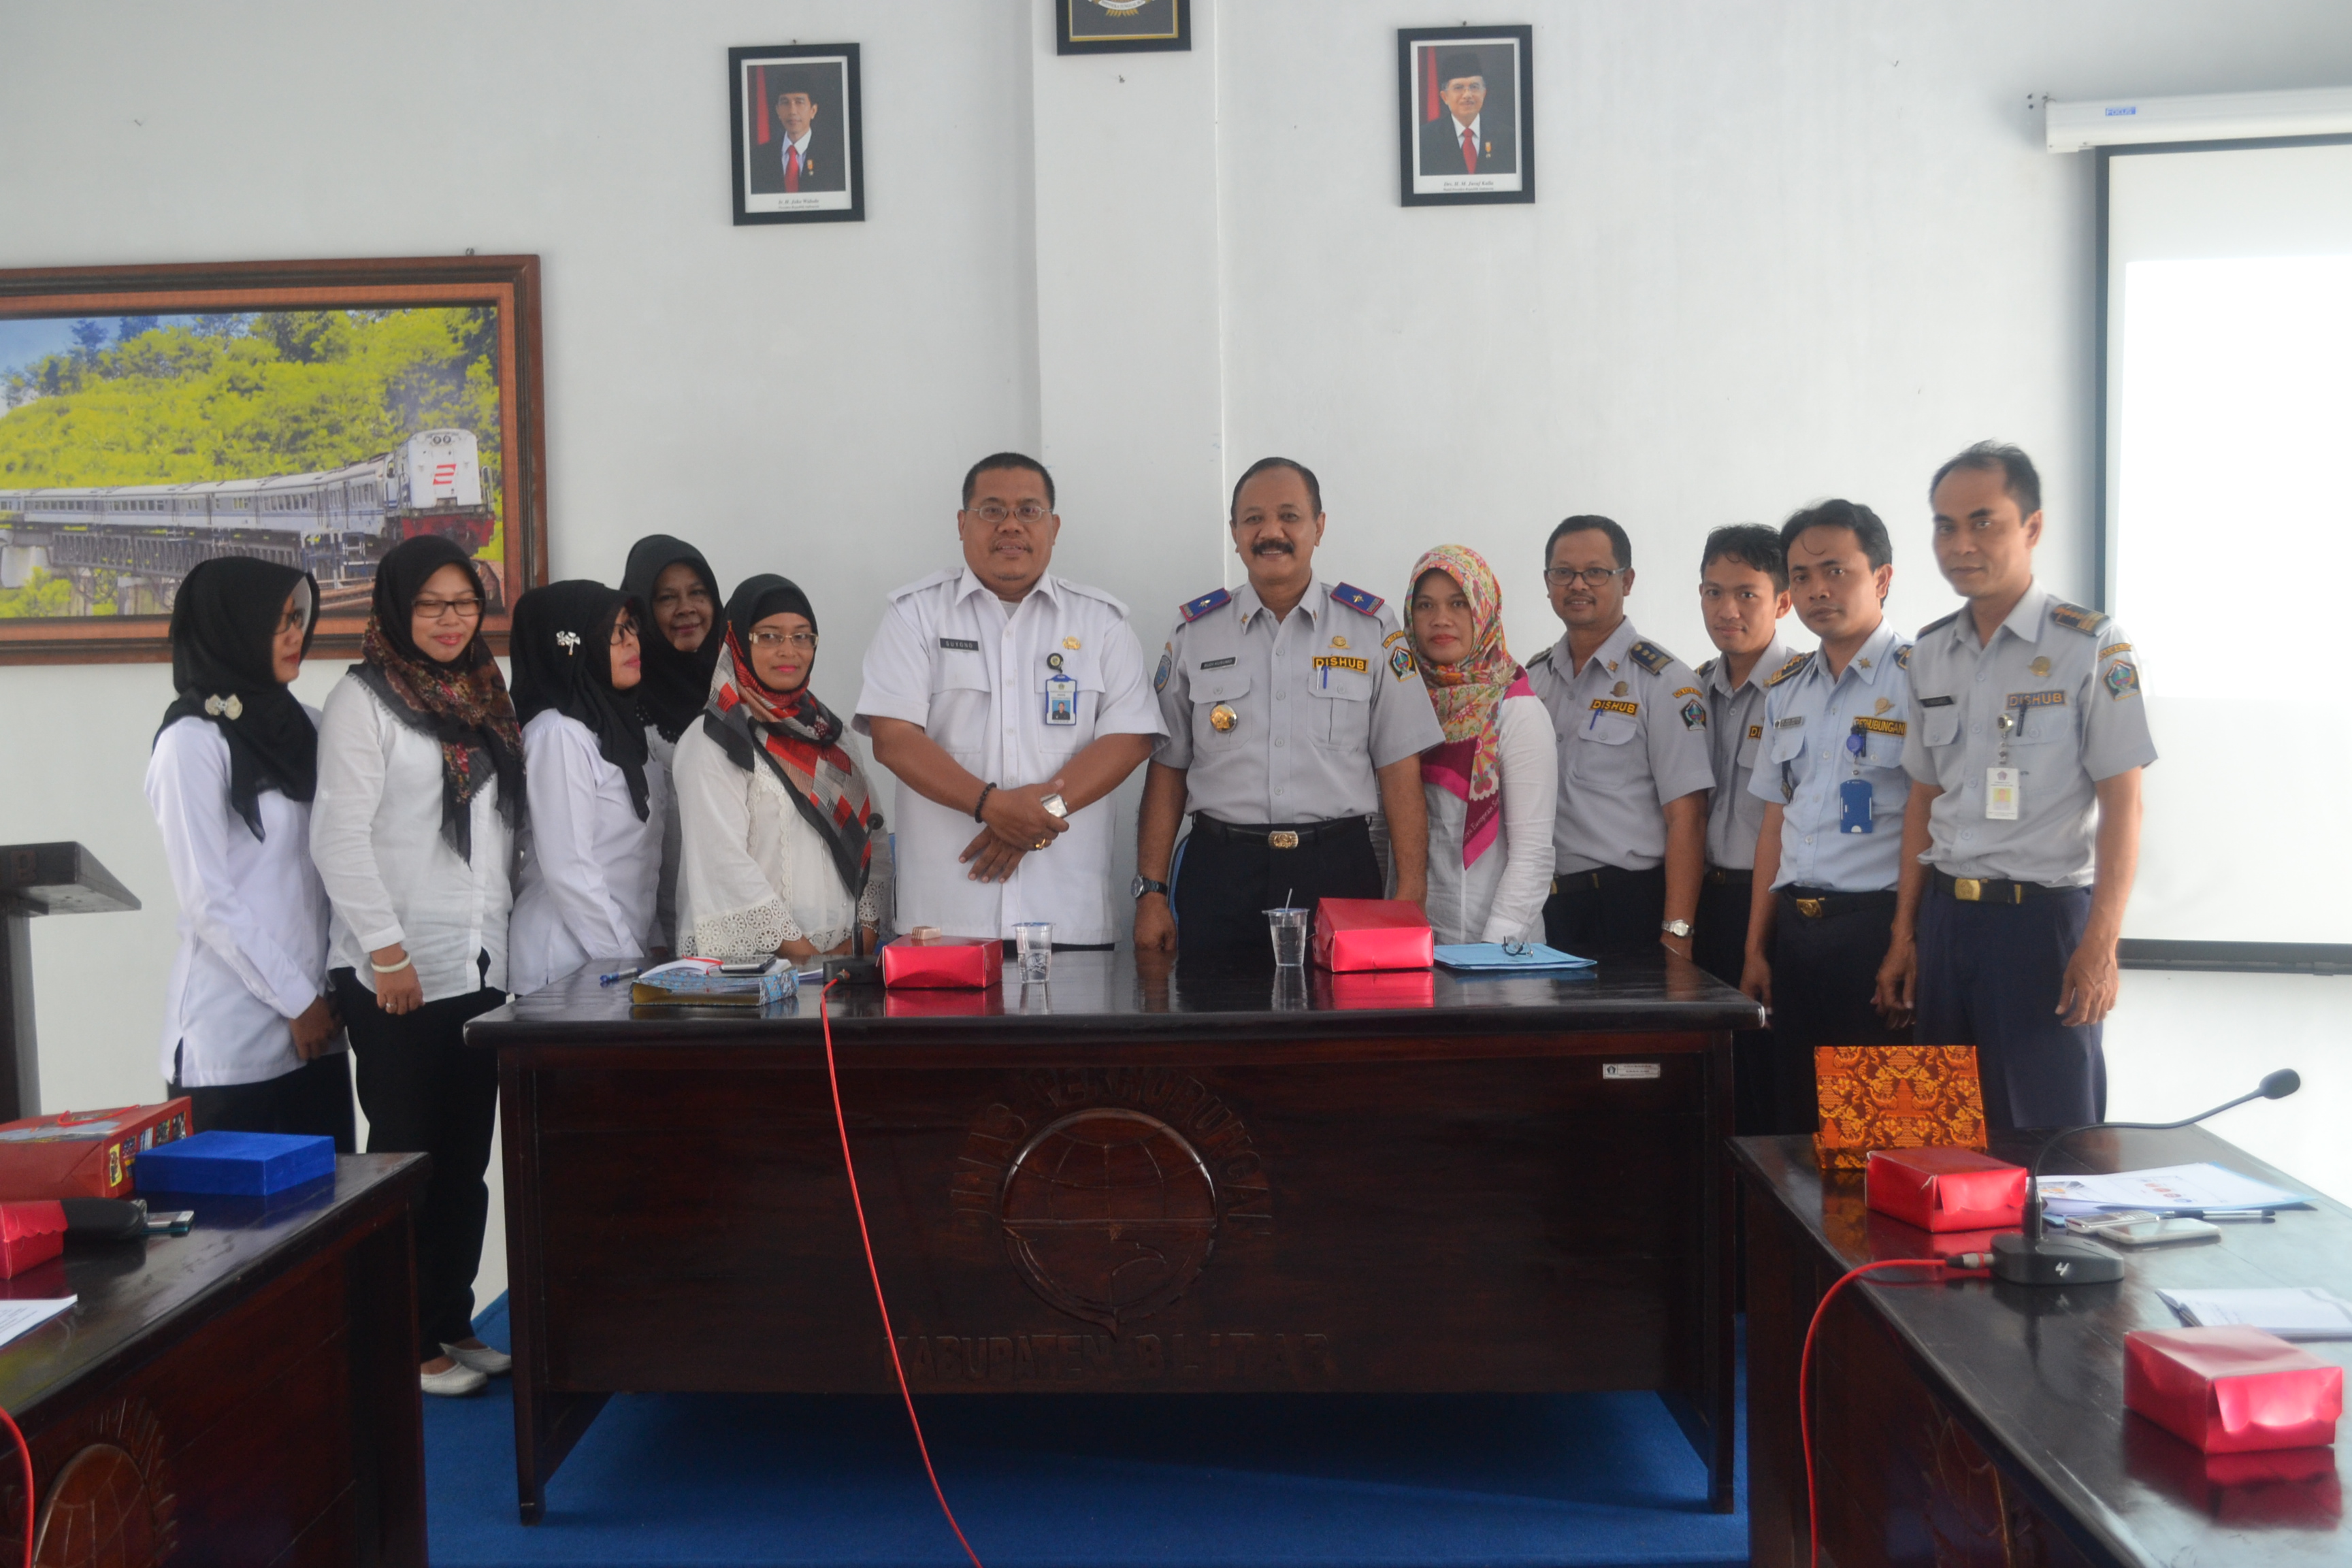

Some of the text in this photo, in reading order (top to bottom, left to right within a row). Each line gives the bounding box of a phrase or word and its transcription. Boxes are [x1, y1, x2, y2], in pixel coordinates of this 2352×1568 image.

[945, 640, 973, 649] SUYONO
[1316, 657, 1365, 670] DISHUB
[2009, 693, 2062, 706] DISHUB
[1592, 700, 1636, 714] DISHUB
